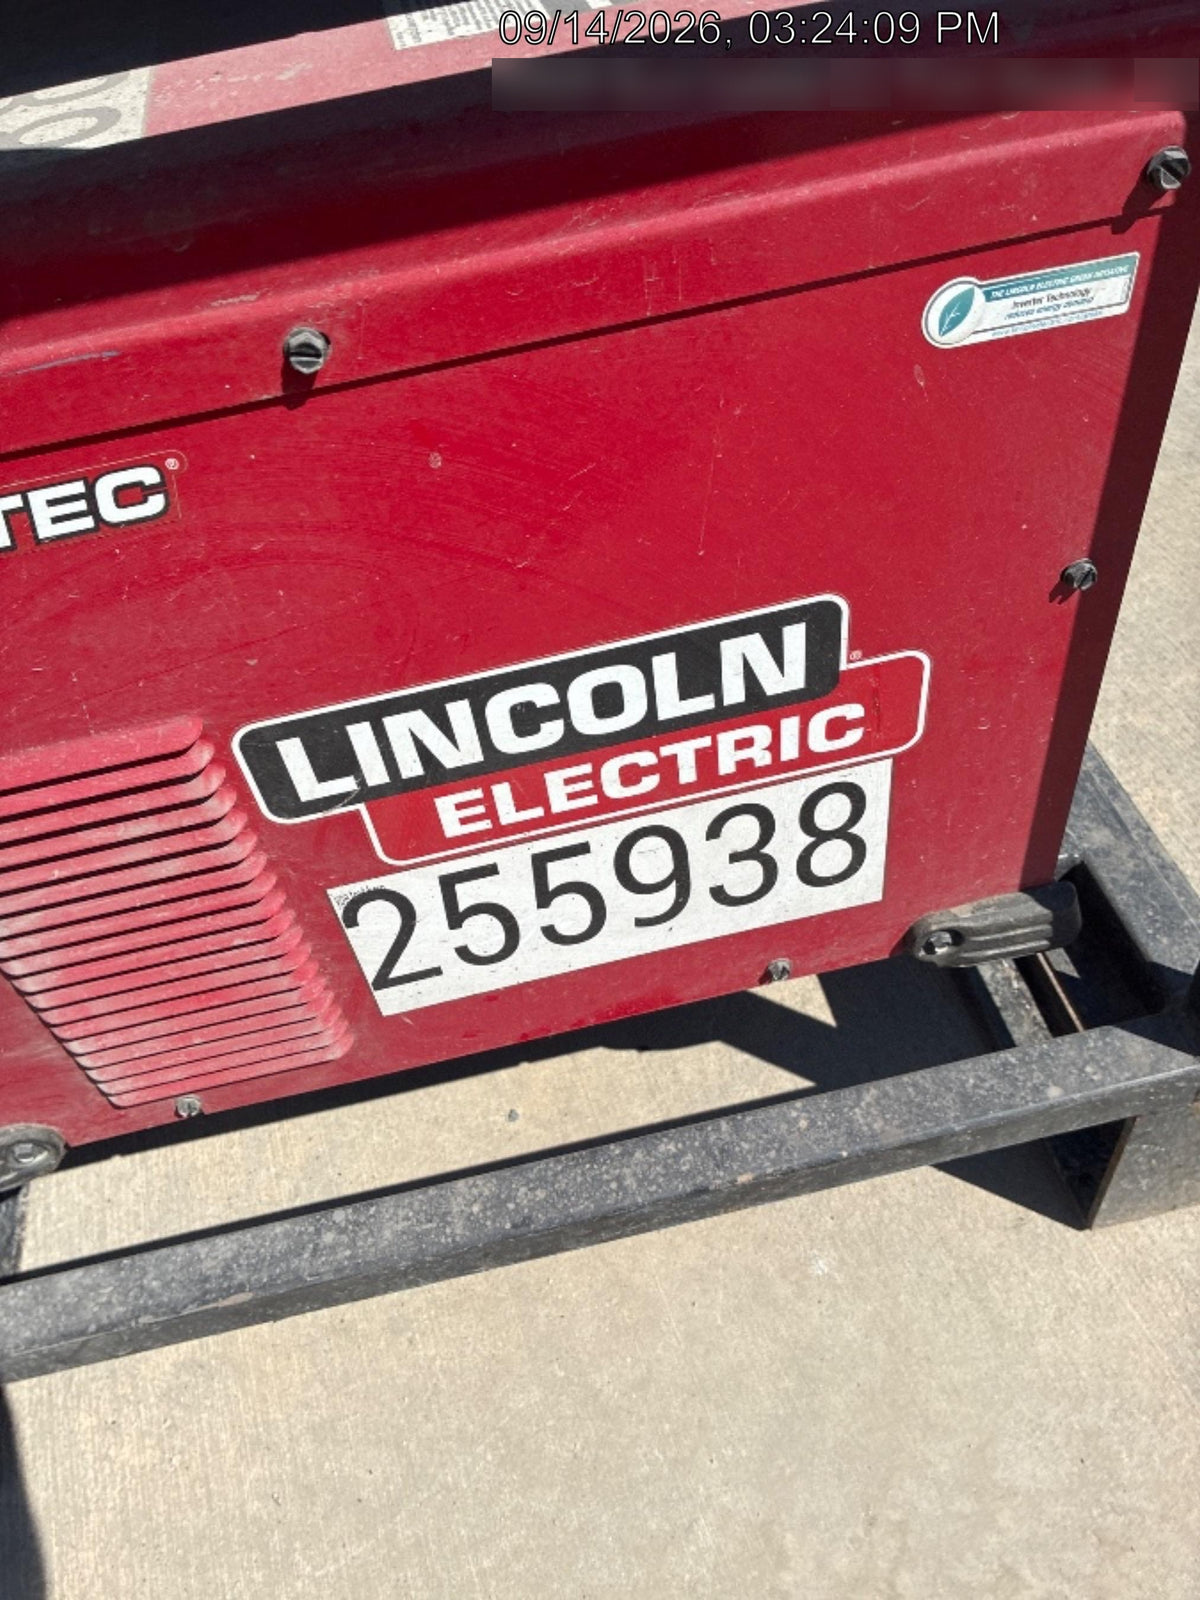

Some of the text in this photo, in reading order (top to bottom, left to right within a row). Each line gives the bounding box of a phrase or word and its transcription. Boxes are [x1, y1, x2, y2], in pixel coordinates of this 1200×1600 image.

[276, 621, 807, 803] LINCOLN
[434, 703, 865, 839] ELECTRIC
[343, 781, 867, 991] 255938
